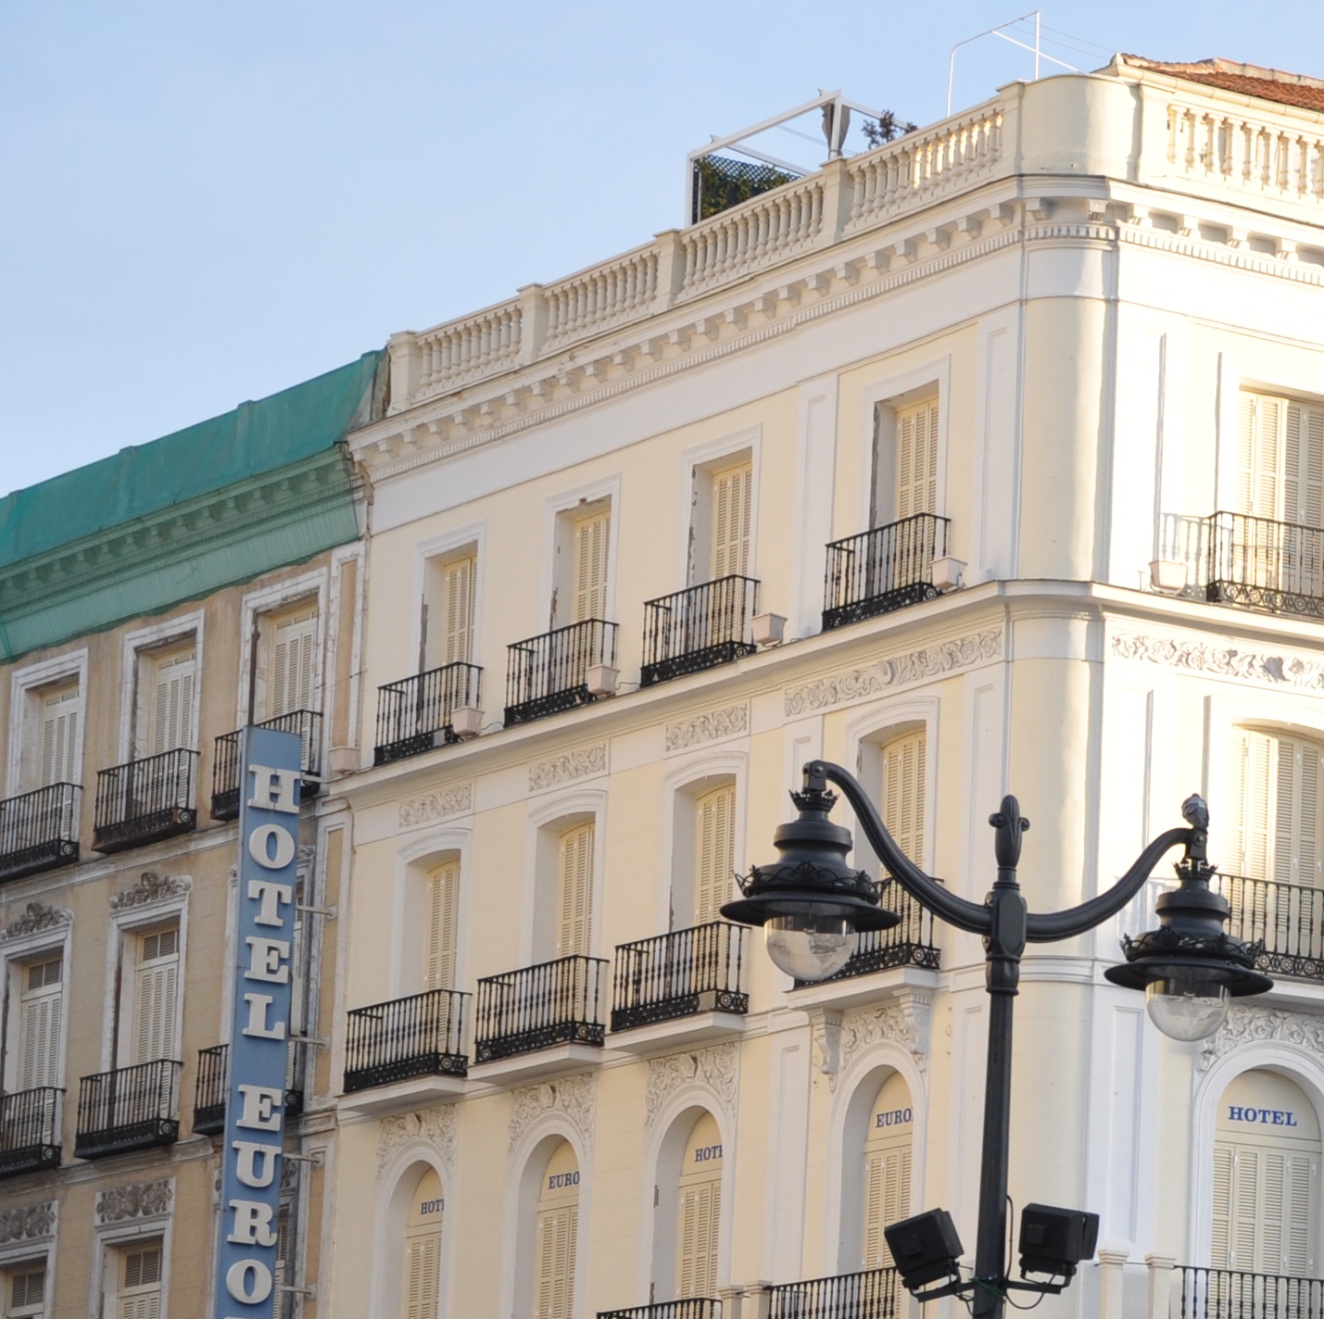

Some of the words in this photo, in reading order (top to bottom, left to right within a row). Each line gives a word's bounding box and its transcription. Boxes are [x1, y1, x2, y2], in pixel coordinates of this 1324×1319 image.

[242, 763, 300, 1041] HOTEL
[876, 1107, 914, 1129] EURO
[1228, 1105, 1298, 1128] HOTEL
[695, 1144, 723, 1163] HOT
[548, 1171, 580, 1190] EURO
[420, 1198, 445, 1216] HOT
